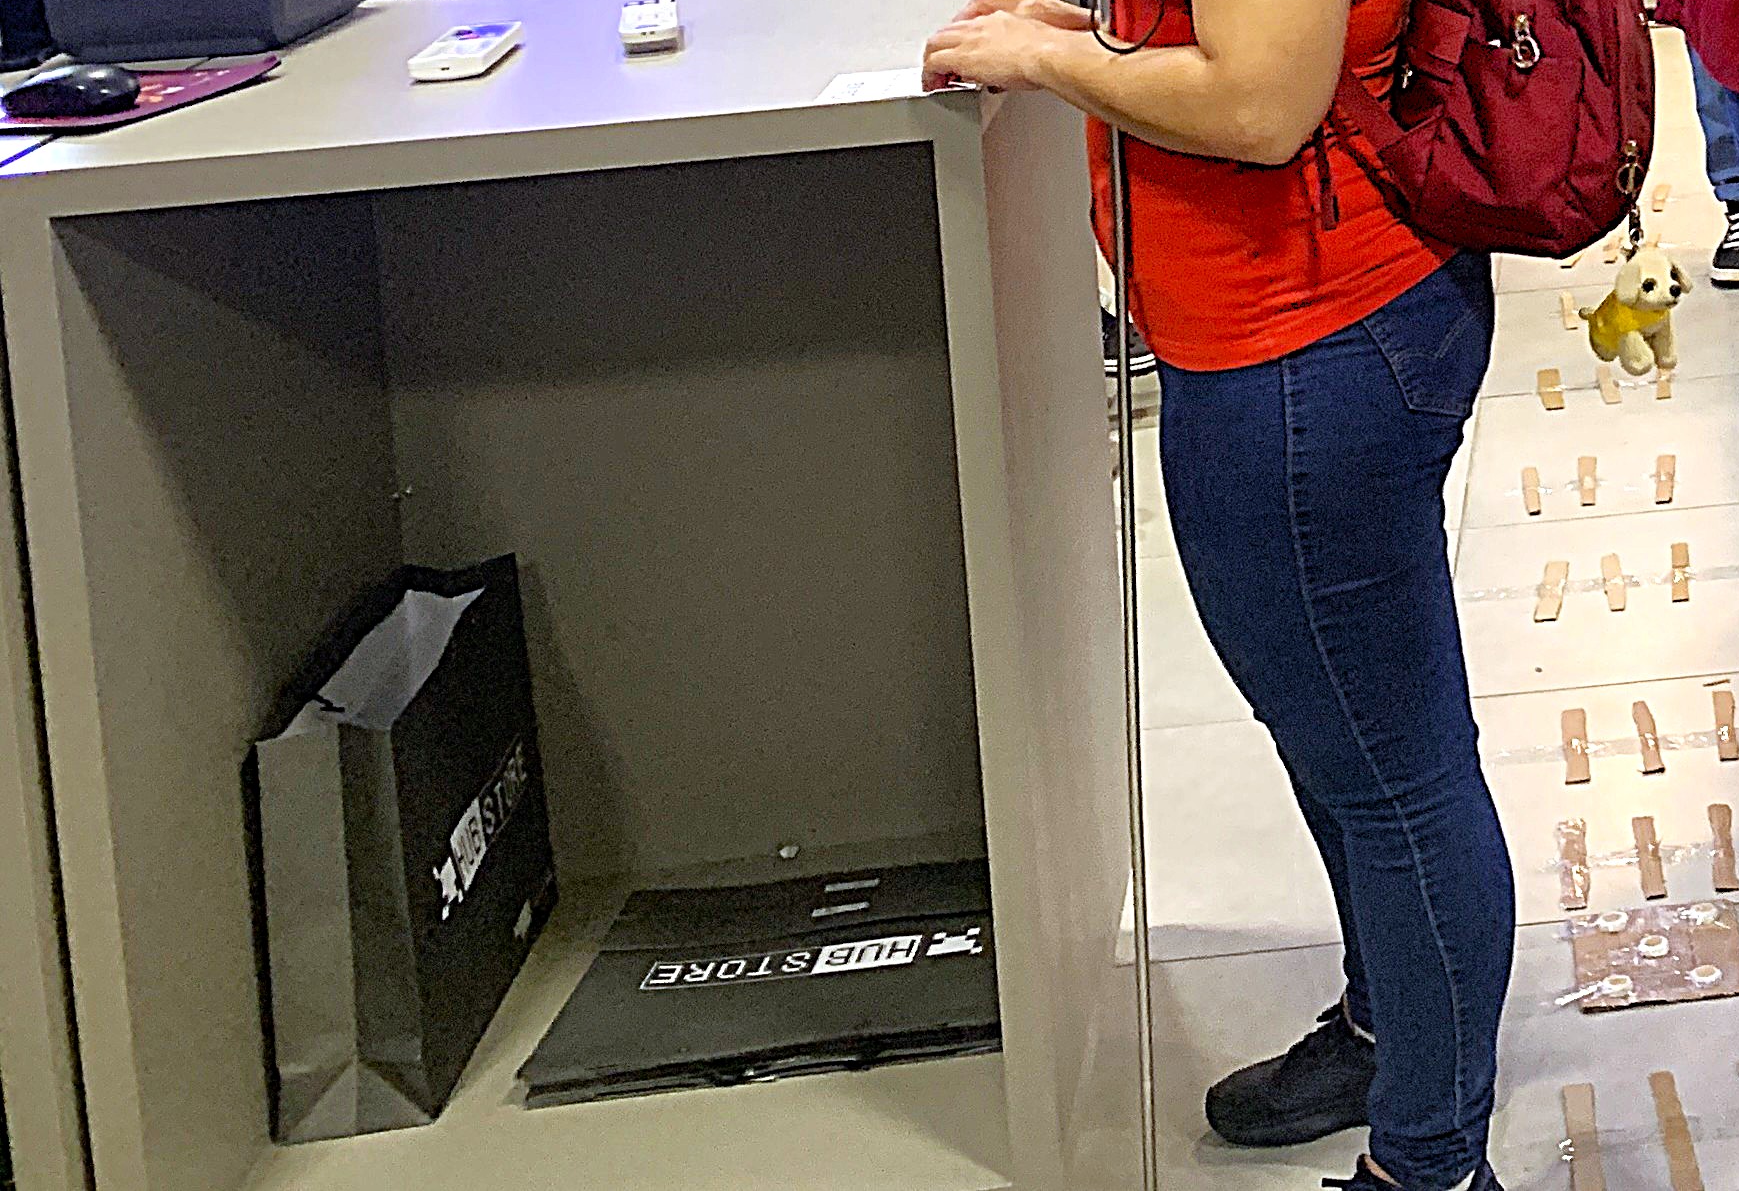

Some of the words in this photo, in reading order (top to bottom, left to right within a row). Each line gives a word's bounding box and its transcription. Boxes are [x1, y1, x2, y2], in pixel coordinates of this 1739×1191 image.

[452, 813, 484, 885] HUB
[649, 951, 812, 986] STORE
[826, 936, 919, 968] HUB
